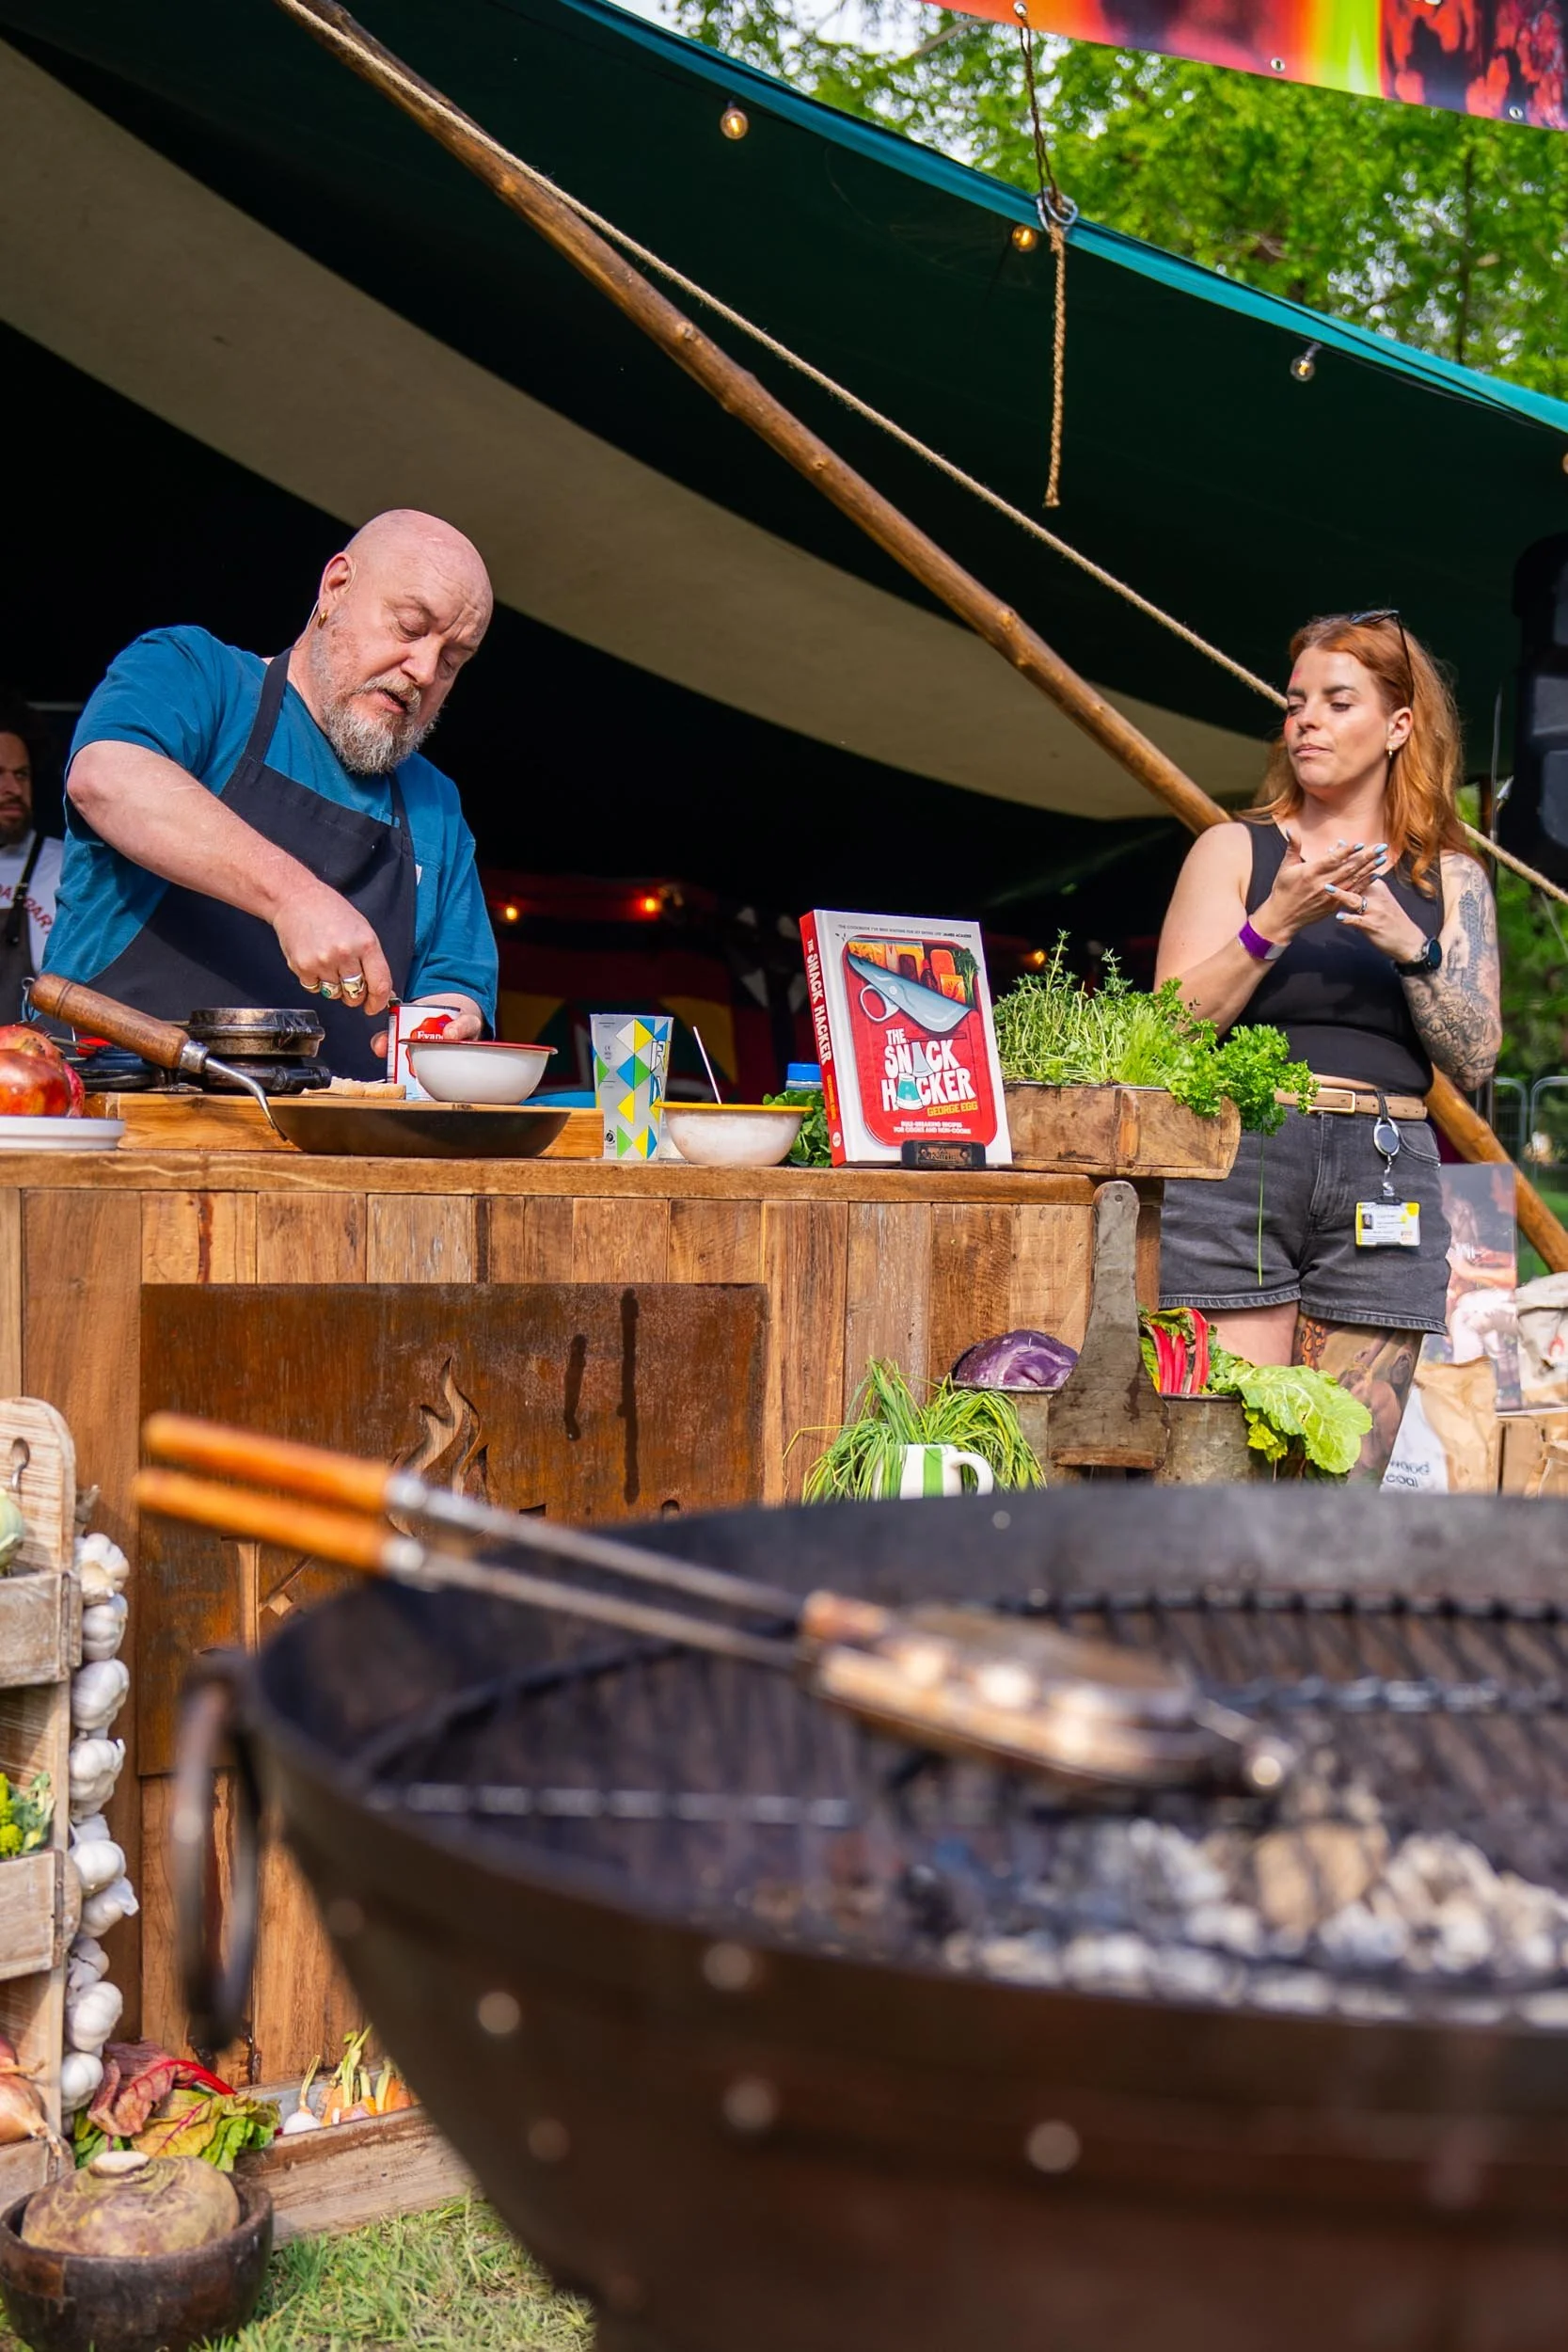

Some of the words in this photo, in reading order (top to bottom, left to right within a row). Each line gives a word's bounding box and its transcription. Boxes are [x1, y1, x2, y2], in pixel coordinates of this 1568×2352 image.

[807, 953, 824, 1005] SNACK
[814, 1004, 832, 1066] HACKER
[885, 1027, 907, 1046] THE
[884, 1039, 960, 1079] SNACK
[881, 1067, 977, 1112] HACKER
[927, 1104, 959, 1117] GEORGE
[960, 1101, 978, 1112] EGG
